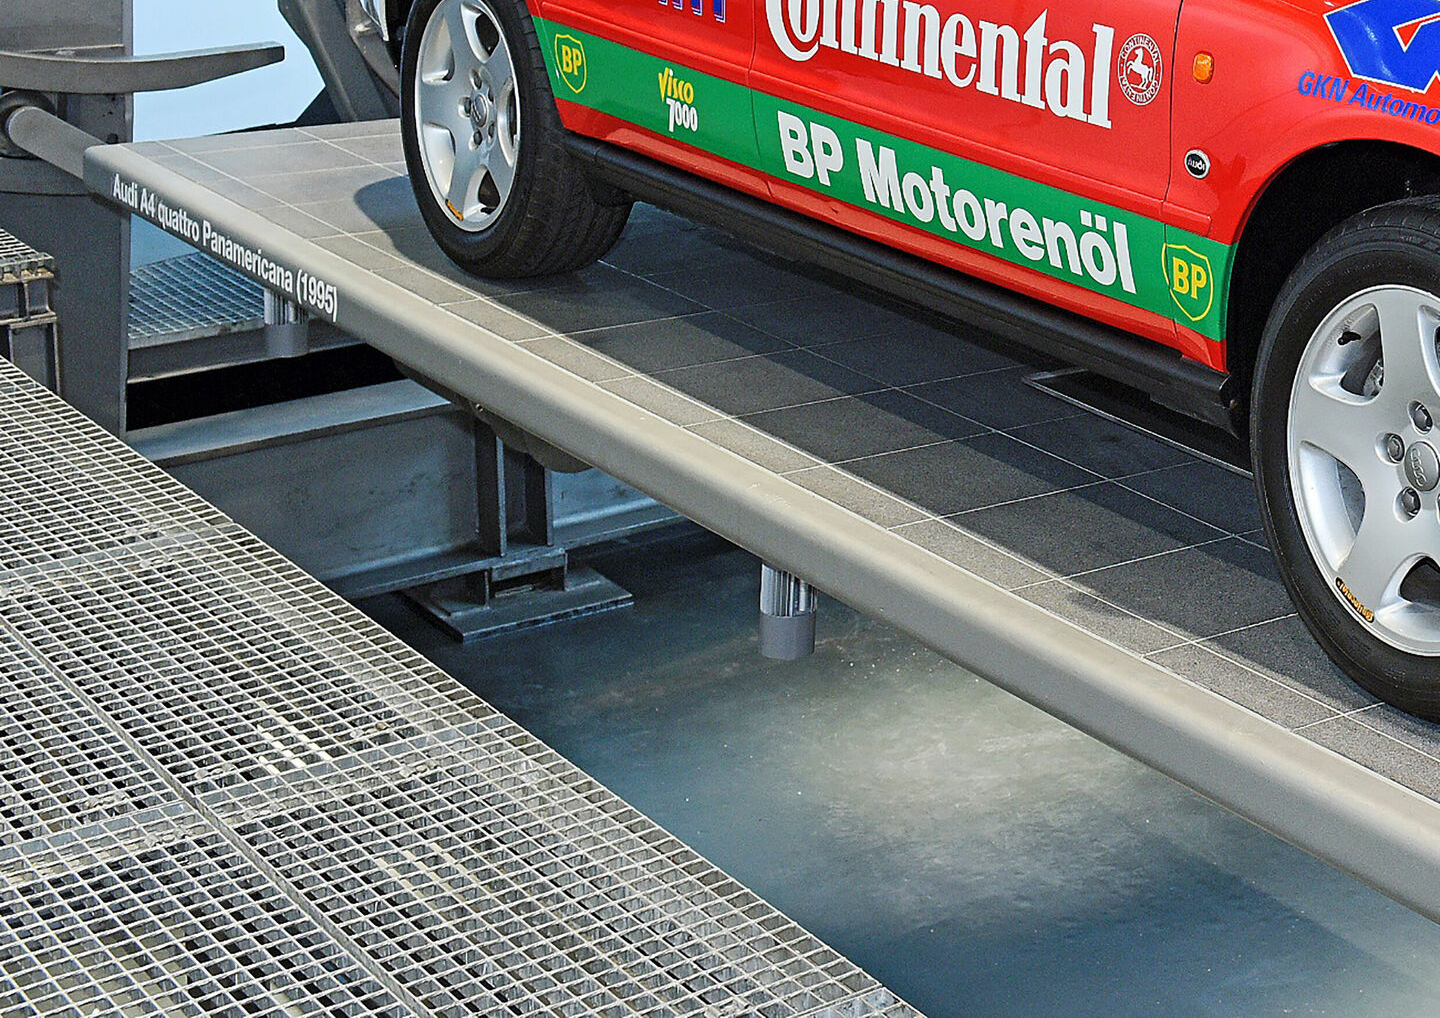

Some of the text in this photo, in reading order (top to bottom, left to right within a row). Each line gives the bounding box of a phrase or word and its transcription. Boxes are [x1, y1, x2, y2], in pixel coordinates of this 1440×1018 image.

[561, 45, 582, 76] BP
[1298, 71, 1348, 102] GKN
[666, 98, 698, 132] 7000
[777, 110, 1137, 294] BP Motorenöl
[112, 174, 338, 323] Audi A4 quattro Panamericana (1995)
[1170, 258, 1208, 301] BP
